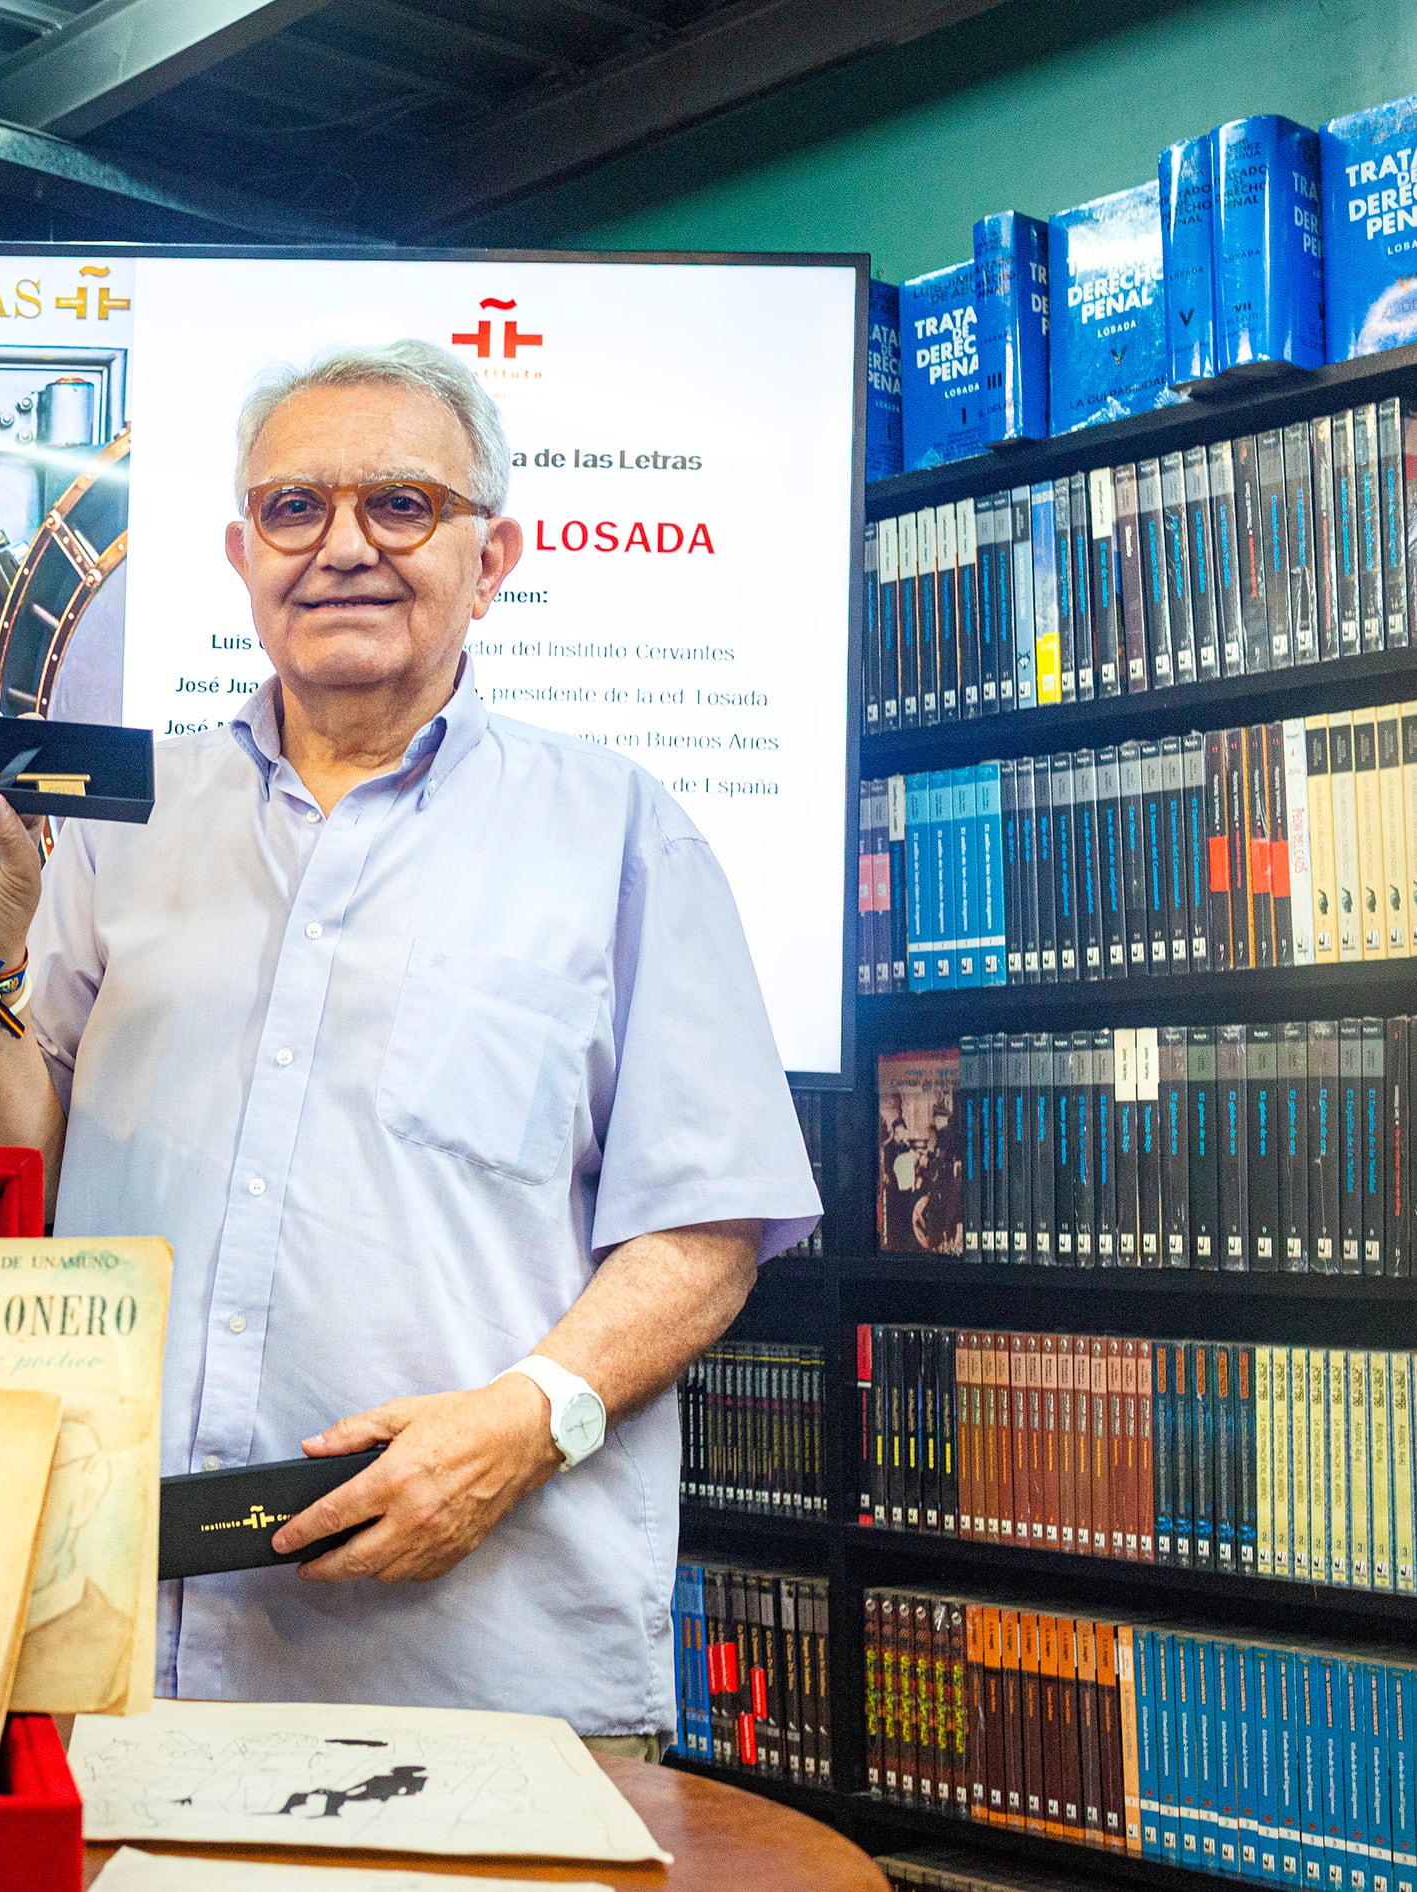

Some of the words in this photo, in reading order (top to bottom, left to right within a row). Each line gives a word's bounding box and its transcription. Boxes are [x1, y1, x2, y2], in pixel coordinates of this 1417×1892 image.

[1348, 182, 1417, 223] DERE
[1066, 261, 1164, 309] DERECHO
[1081, 284, 1154, 326] PENAL
[914, 305, 978, 340] TRATA
[1178, 307, 1195, 328] V
[951, 324, 970, 342] DE
[916, 334, 977, 370] DEREC
[929, 354, 979, 386] PENA
[986, 371, 1003, 392] III
[533, 446, 568, 468] de
[574, 447, 615, 470] las
[618, 448, 704, 472] Letras
[535, 519, 717, 556] LOSADA
[210, 633, 253, 651] Luis
[511, 639, 541, 657] del
[548, 640, 628, 660] Instituto
[635, 642, 736, 664] Cervantes
[175, 675, 220, 694] José
[491, 684, 598, 706] presidente
[603, 686, 629, 704] de
[636, 687, 654, 705] la
[163, 718, 209, 736] José
[615, 734, 640, 748] en
[646, 730, 722, 750] Buenos
[729, 732, 780, 752] Aires
[672, 775, 697, 794] de
[705, 776, 779, 799] España
[1, 1255, 21, 1271] DE
[31, 1253, 120, 1271] UNAMUNO
[200, 1520, 241, 1532] Instituto
